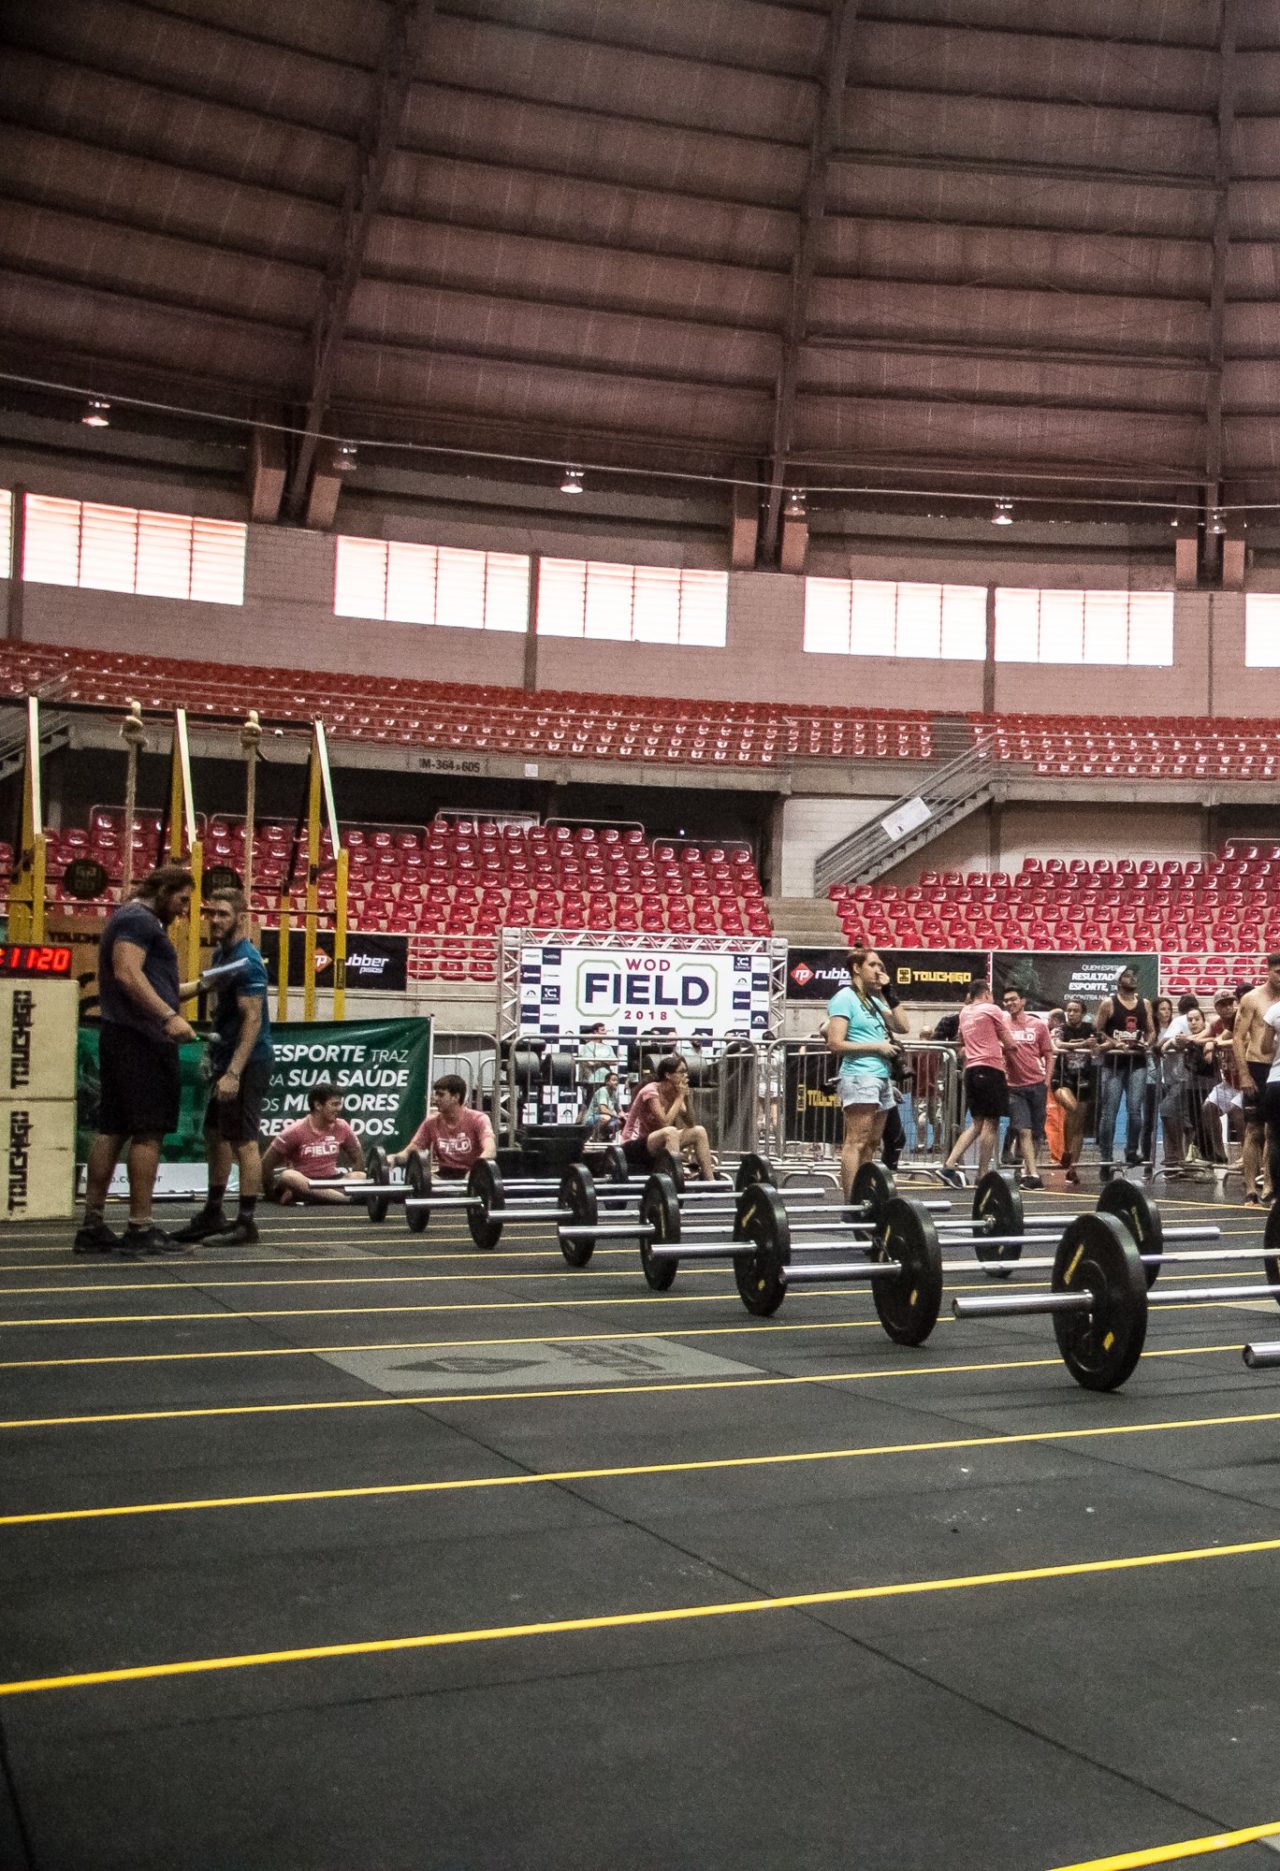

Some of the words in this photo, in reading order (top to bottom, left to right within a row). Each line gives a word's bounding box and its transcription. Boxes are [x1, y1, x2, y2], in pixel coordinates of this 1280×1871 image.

[626, 958, 671, 972] WOD
[585, 973, 710, 1007] FIELD
[624, 1010, 668, 1020] 2018
[273, 1044, 367, 1063] ESPORTE
[371, 1049, 409, 1063] TRAZ
[288, 1069, 331, 1087] SUA
[336, 1064, 410, 1088] SAÚDE
